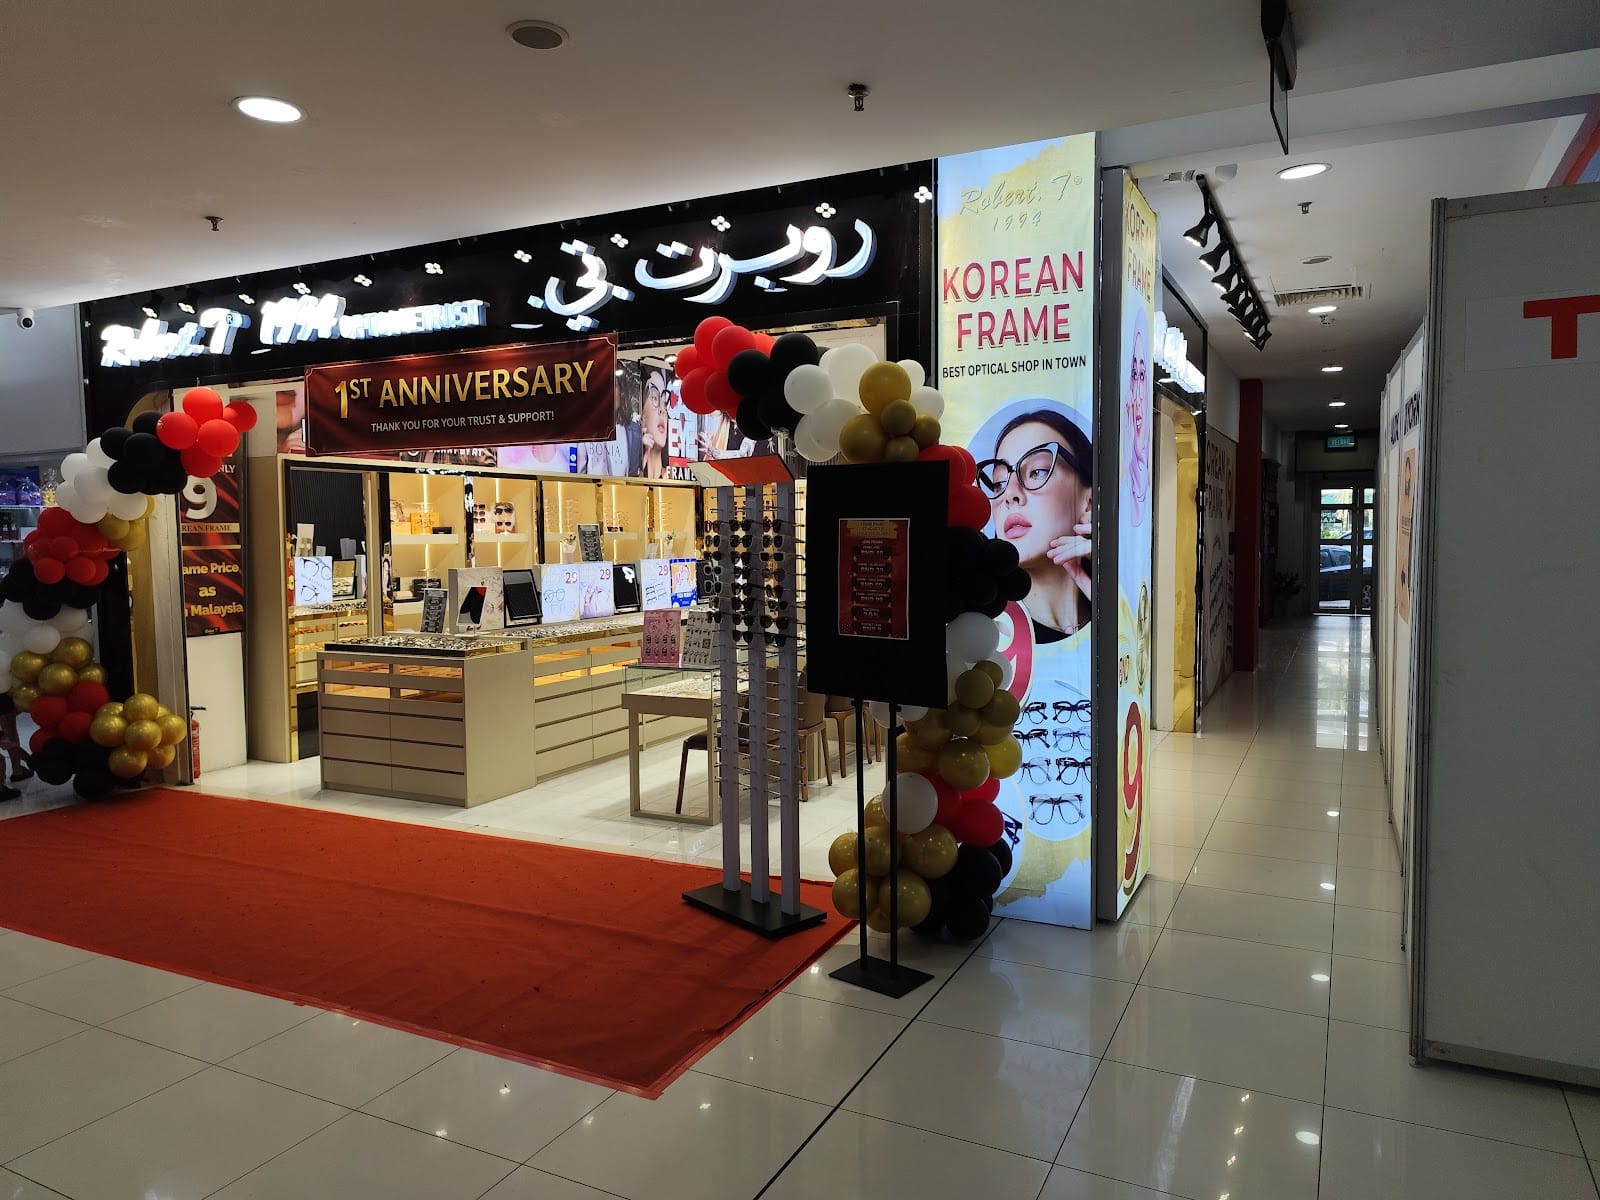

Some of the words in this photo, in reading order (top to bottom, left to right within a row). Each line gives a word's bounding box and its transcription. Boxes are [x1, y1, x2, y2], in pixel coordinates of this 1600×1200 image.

[942, 251, 1084, 303] KOREAN
[957, 303, 1071, 351] FRAME
[1524, 294, 1600, 360] T
[942, 361, 967, 379] BEST
[967, 361, 1010, 377] OPTICAL
[1011, 359, 1040, 374] SHOP
[1041, 358, 1053, 371] IN
[1054, 355, 1087, 369] TOWN
[379, 359, 595, 409] ANNIVERSARY
[334, 376, 373, 419] 1ST
[371, 421, 401, 433] THANK
[401, 420, 421, 431] YOU
[422, 418, 440, 430] FOR
[440, 416, 467, 428] YOUR
[467, 414, 496, 426] TRUST
[498, 414, 506, 424] &
[507, 410, 555, 423] SUPPORT!
[589, 443, 621, 458] BONIA
[217, 464, 236, 473] NLY
[183, 475, 218, 520] 9
[182, 565, 208, 575] ame
[210, 562, 240, 573] Price
[565, 571, 578, 584] 29
[600, 568, 612, 581] 29
[199, 585, 217, 597] as
[191, 601, 244, 618] Malaysia
[1123, 701, 1143, 883] 9
